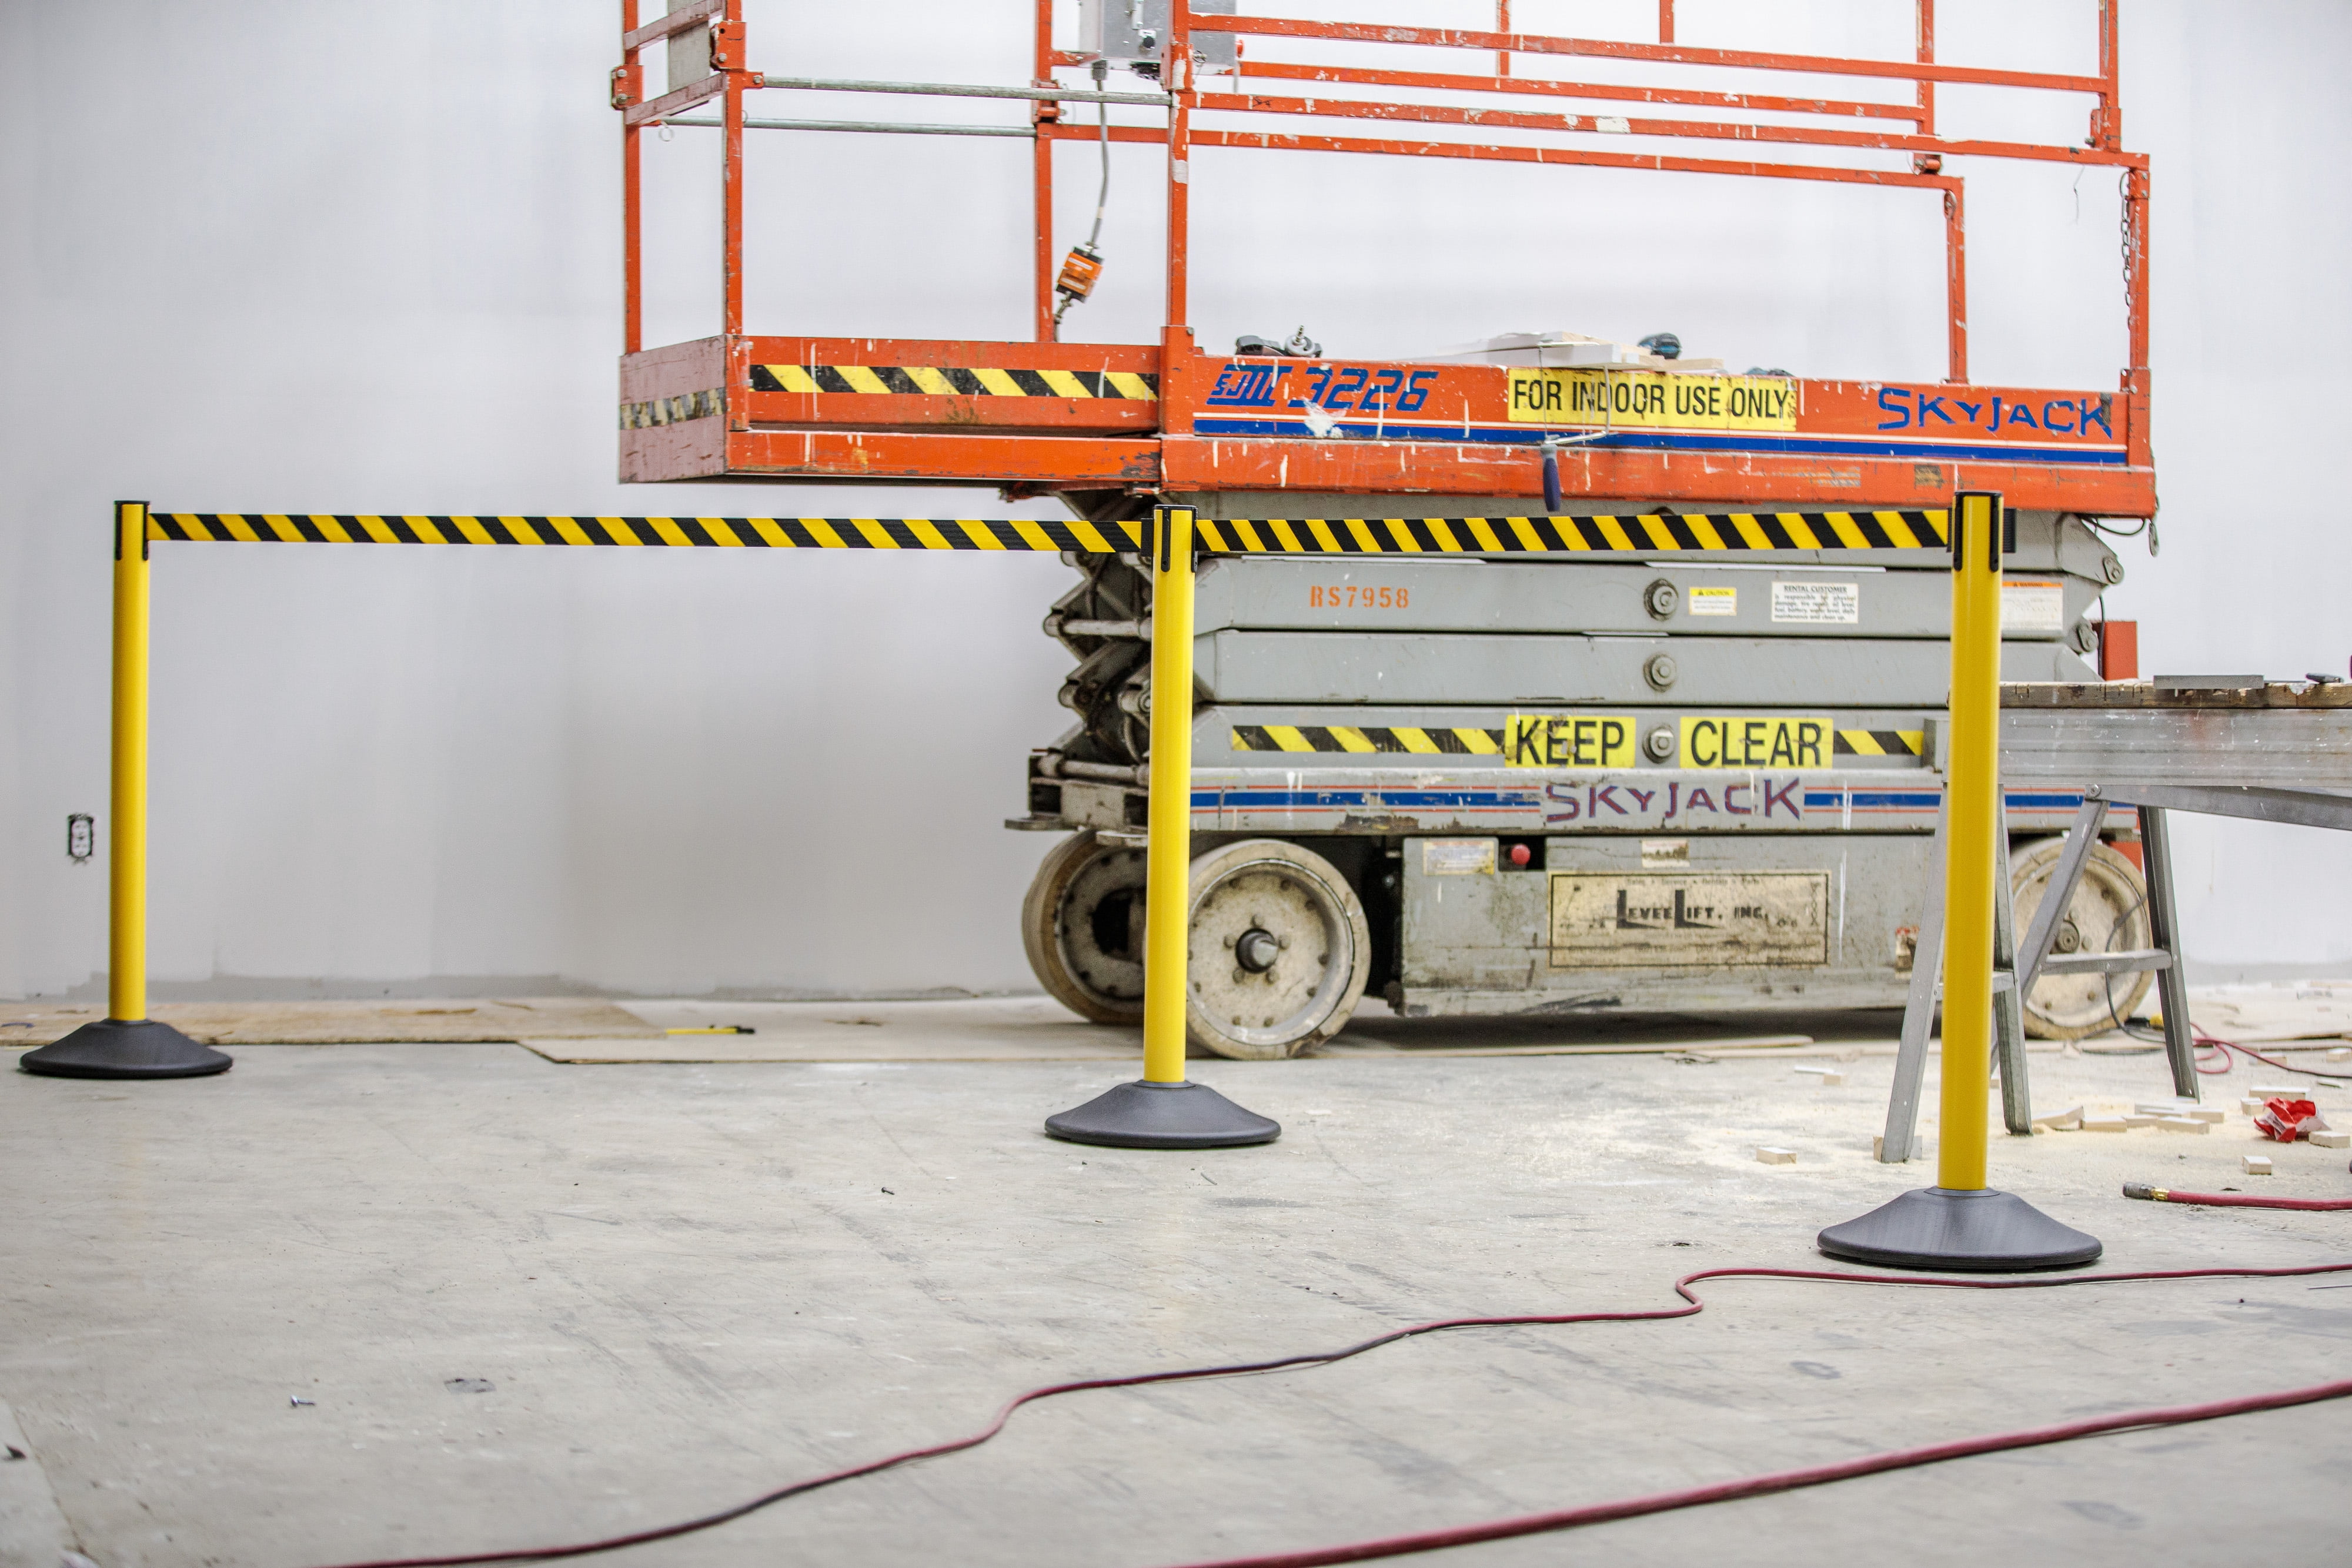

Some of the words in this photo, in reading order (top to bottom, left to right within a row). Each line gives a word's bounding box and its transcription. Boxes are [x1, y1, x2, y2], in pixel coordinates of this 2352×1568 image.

[1288, 366, 1439, 412] 3226
[1514, 379, 1562, 410] FOR
[1572, 381, 1666, 414] INDOOR
[1676, 385, 1721, 416] USE
[1730, 387, 1790, 419] ONLY
[1877, 387, 2113, 440] SKYJACK
[1309, 585, 1409, 609] RS7958
[1516, 719, 1625, 765] KEEP
[1690, 720, 1822, 766] CLEAR
[1545, 777, 1801, 823] SKYJACK
